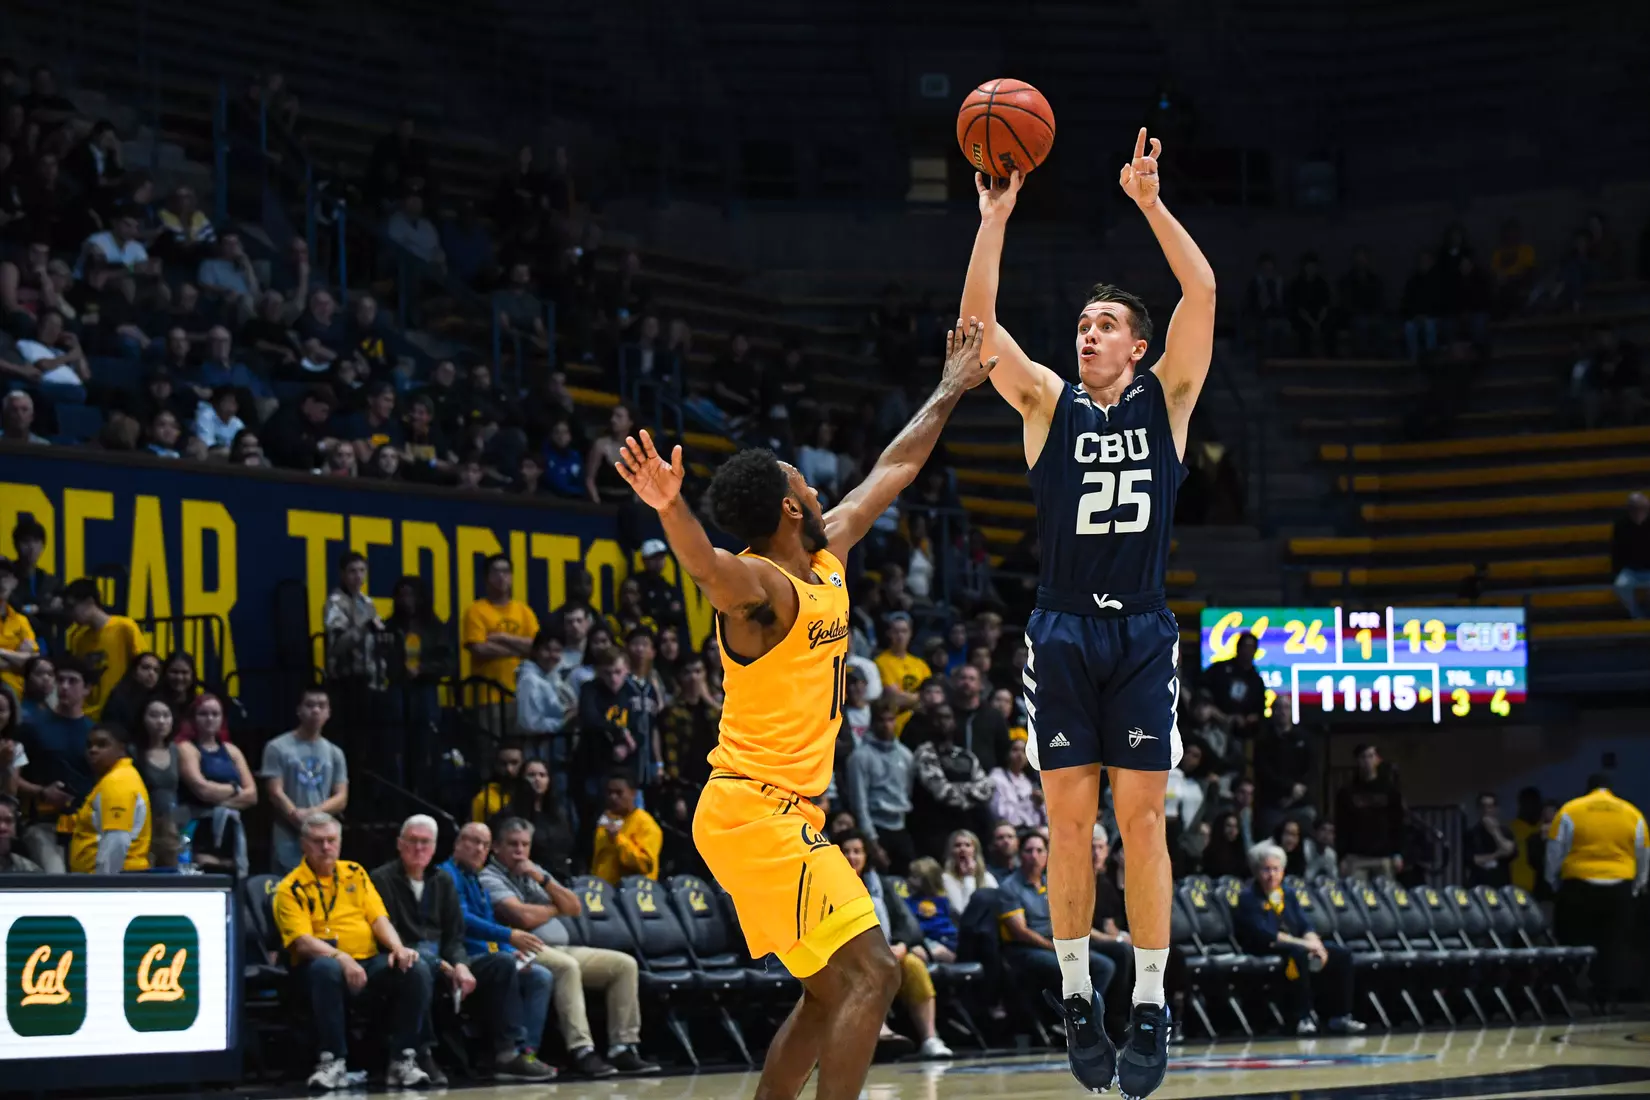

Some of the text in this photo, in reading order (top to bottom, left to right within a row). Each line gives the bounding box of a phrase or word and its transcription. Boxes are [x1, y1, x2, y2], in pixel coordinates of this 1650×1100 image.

[1125, 385, 1144, 402] WAC
[1074, 428, 1150, 463] CBU
[1076, 469, 1152, 534] 25
[287, 509, 716, 706] TERRITOY
[1284, 620, 1327, 654] 24
[1355, 628, 1372, 660] 1
[1403, 619, 1447, 653] 13
[1316, 675, 1417, 711] 11:15
[1451, 688, 1470, 716] 3
[21, 945, 73, 1006] Cal
[136, 943, 187, 1003] Cal
